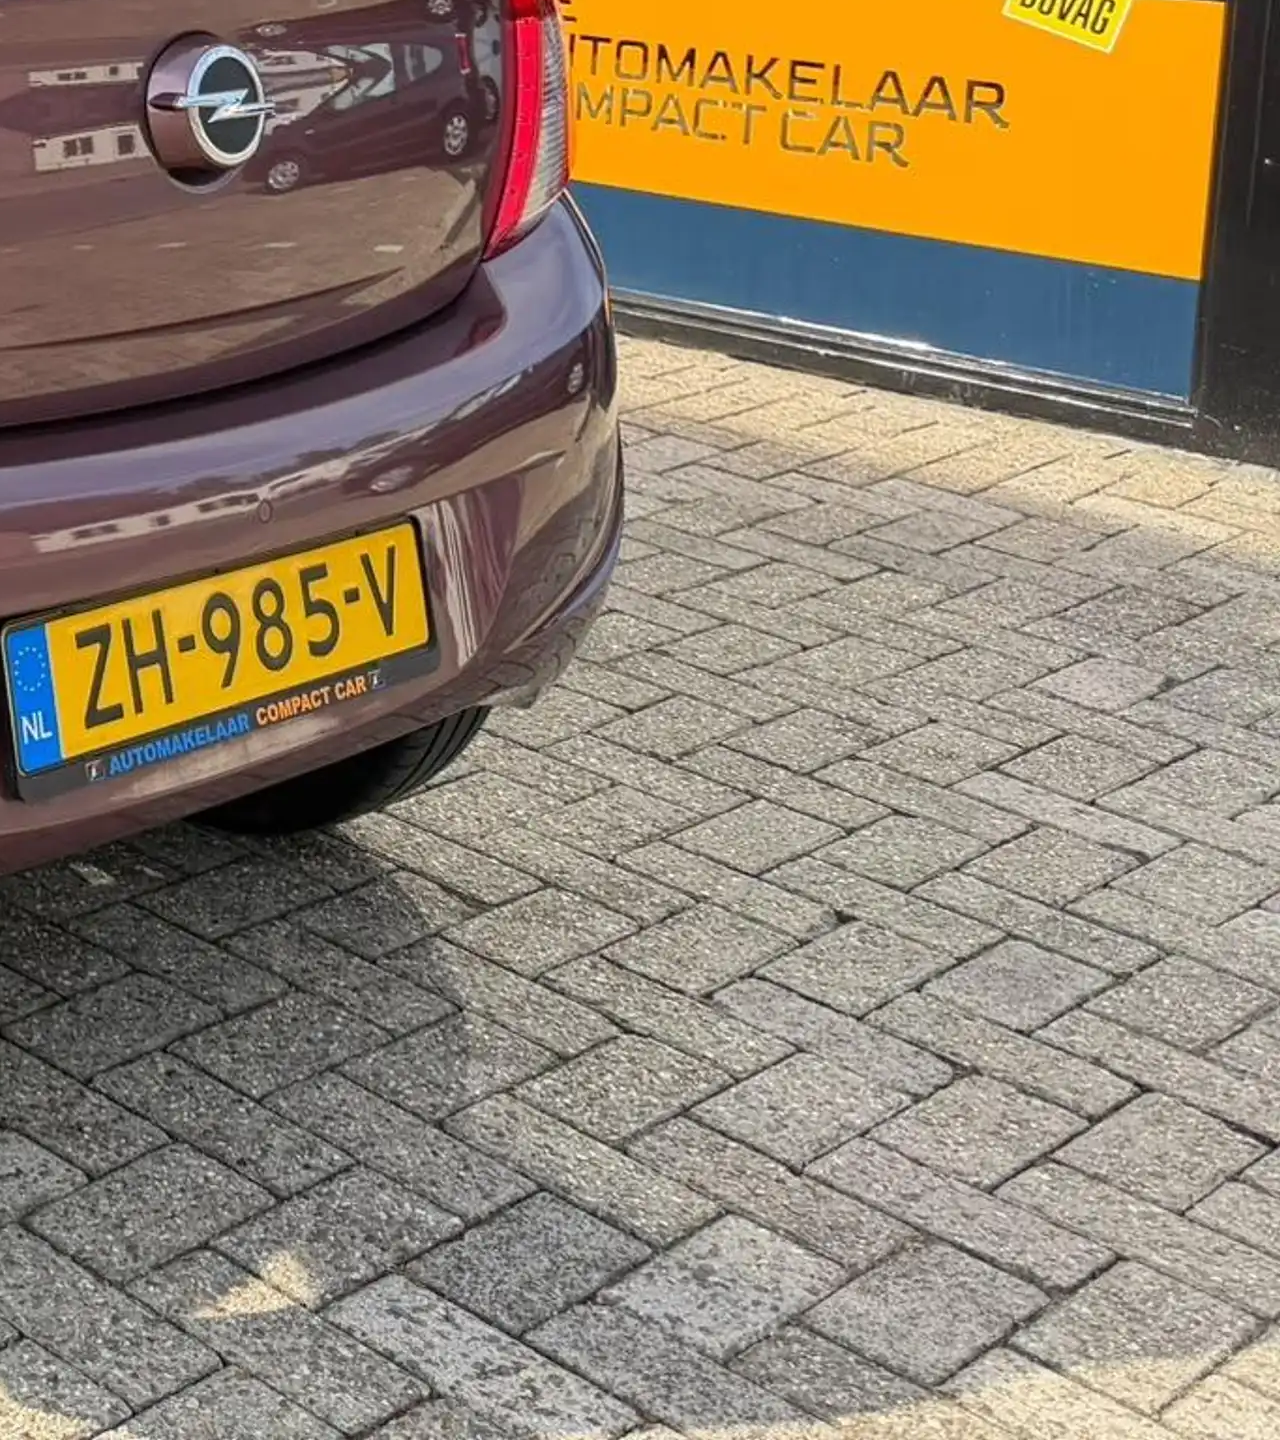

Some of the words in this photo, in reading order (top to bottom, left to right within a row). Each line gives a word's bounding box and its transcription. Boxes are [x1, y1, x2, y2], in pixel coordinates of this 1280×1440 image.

[569, 34, 1011, 130] TOMAKELAAR
[575, 80, 767, 146] MPACT
[780, 110, 911, 168] CAR
[74, 544, 397, 730] ZH-985-V
[21, 715, 53, 746] NL
[109, 712, 250, 776] AUTOMAKELAAR
[255, 687, 330, 726] COMPACT
[335, 674, 368, 701] CAR
